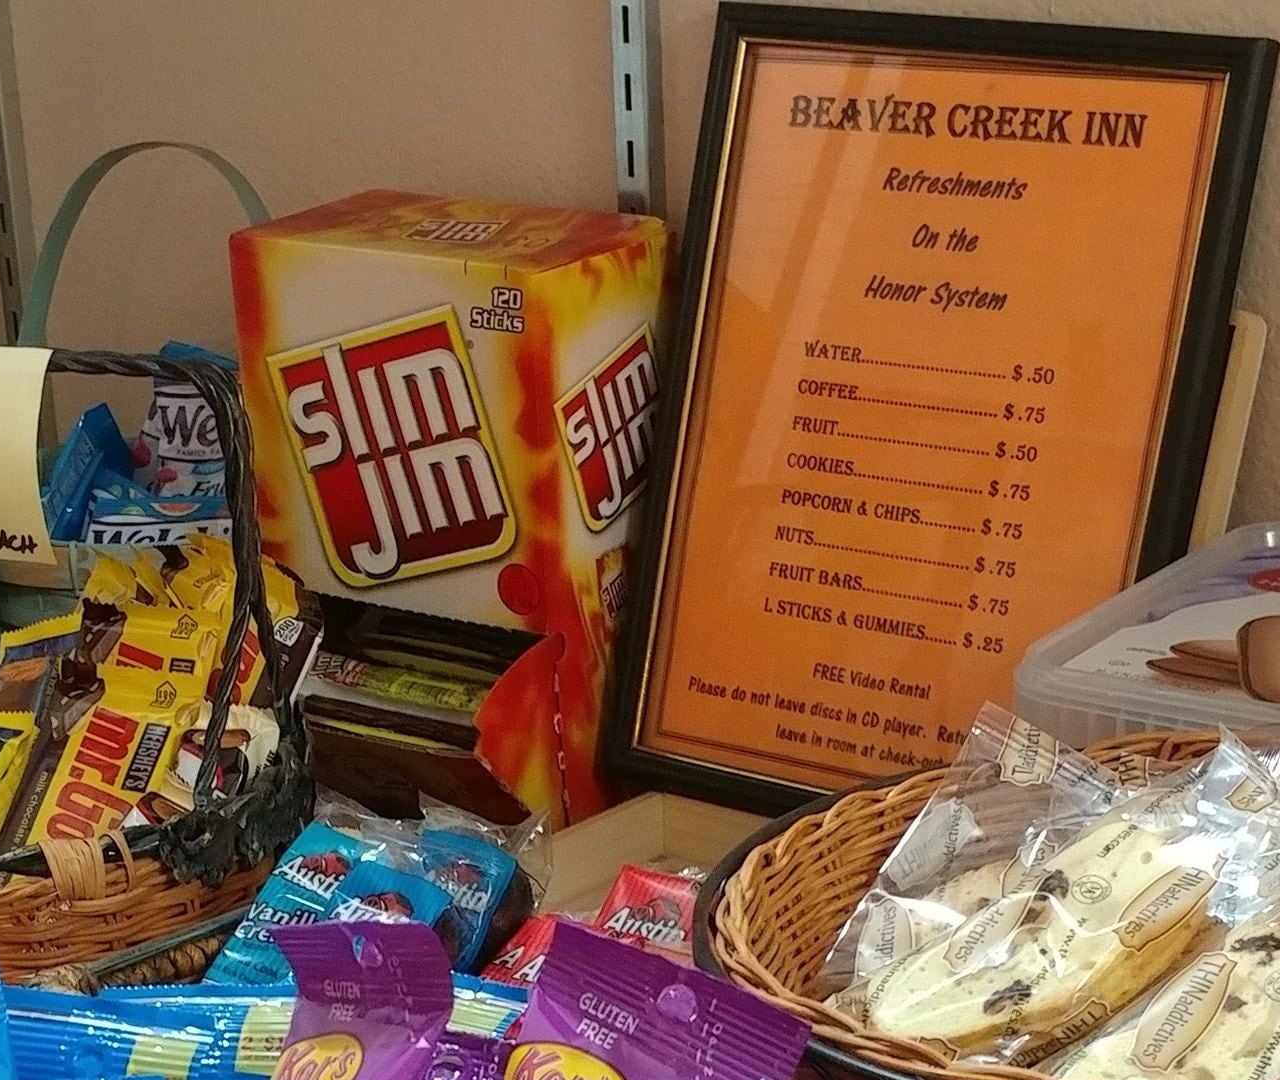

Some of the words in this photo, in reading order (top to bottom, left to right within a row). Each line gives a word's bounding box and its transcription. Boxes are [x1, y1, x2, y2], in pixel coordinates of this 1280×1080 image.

[788, 94, 937, 139] BEAVER
[946, 103, 1075, 146] CREEK
[1081, 111, 1148, 149] INN
[882, 166, 1027, 200] Refreshments
[911, 223, 940, 251] On
[945, 226, 979, 253] the
[490, 286, 524, 311] 120
[864, 274, 927, 305] Honor
[930, 280, 1008, 314] System
[470, 307, 525, 333] Sticks
[781, 488, 852, 517] POPCORN
[856, 500, 869, 518] &
[768, 562, 815, 585] FRUIT
[763, 597, 774, 615] L
[776, 601, 833, 626] STICKS
[836, 609, 850, 626] &
[813, 662, 847, 684] FREE
[850, 668, 886, 691] Video
[889, 677, 932, 700] Rental
[688, 675, 727, 698] Please
[731, 685, 747, 703] do
[750, 689, 771, 706] not
[774, 693, 806, 715] leave
[809, 701, 843, 722] discs
[846, 707, 858, 725] in
[861, 711, 880, 729] CD
[123, 725, 170, 790] HERSHEY'S
[776, 723, 807, 744] leave
[811, 730, 822, 747] in
[826, 735, 857, 755] room
[860, 743, 876, 758] at
[34, 770, 49, 793] milk
[272, 855, 346, 901] Austi
[247, 902, 320, 926] Vanill
[1123, 866, 1209, 940] HINaddictives
[603, 906, 686, 944] Austin
[322, 979, 361, 999] GLUTEN
[328, 1003, 355, 1022] FREE
[578, 992, 640, 1036] GLUTEN
[575, 1017, 619, 1051] FREE
